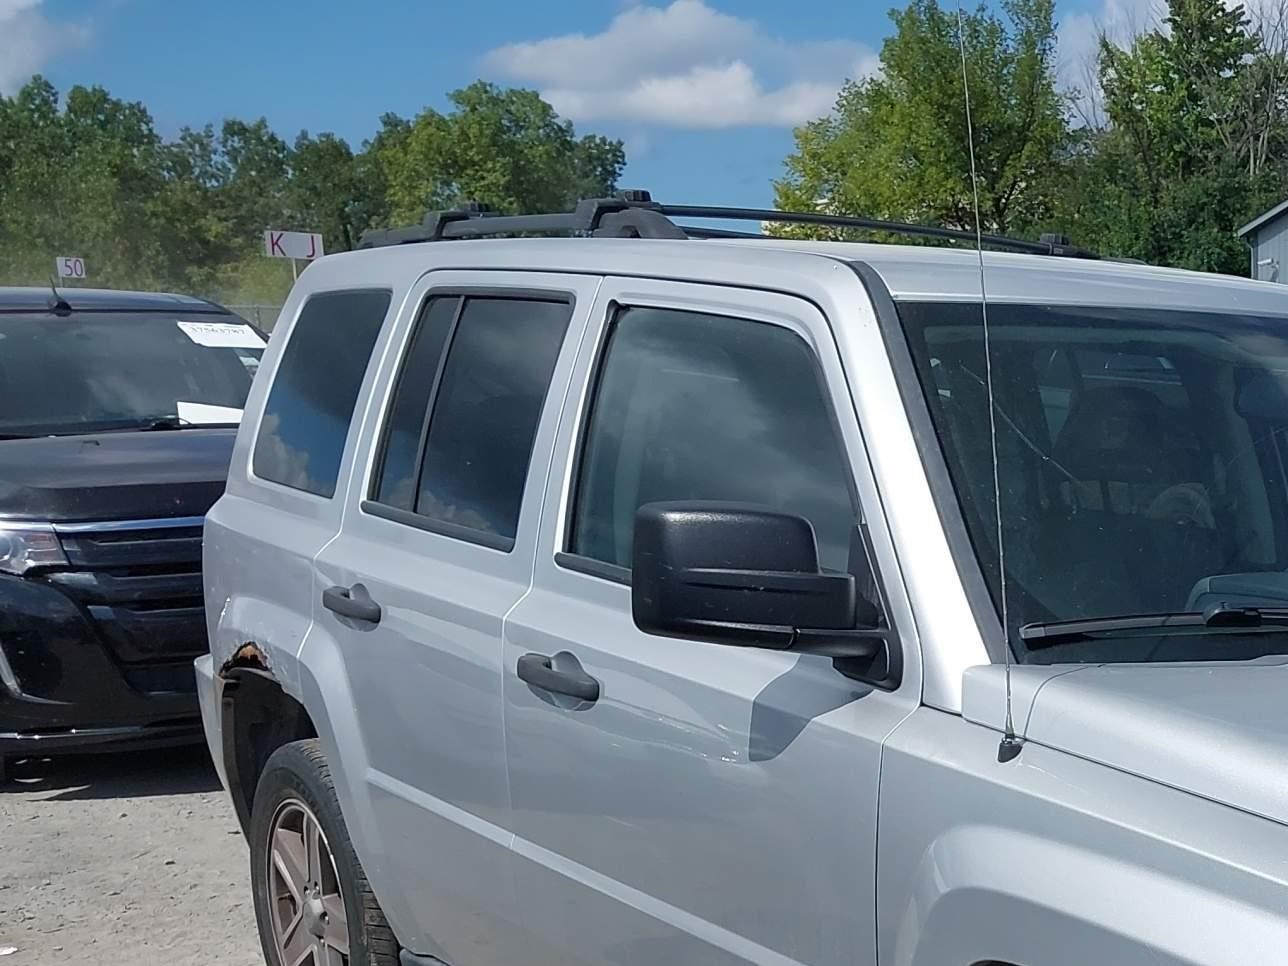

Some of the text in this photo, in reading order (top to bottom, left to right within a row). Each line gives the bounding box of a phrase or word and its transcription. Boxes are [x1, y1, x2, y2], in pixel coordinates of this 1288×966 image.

[270, 231, 316, 259] K J
[64, 258, 84, 277] 50
